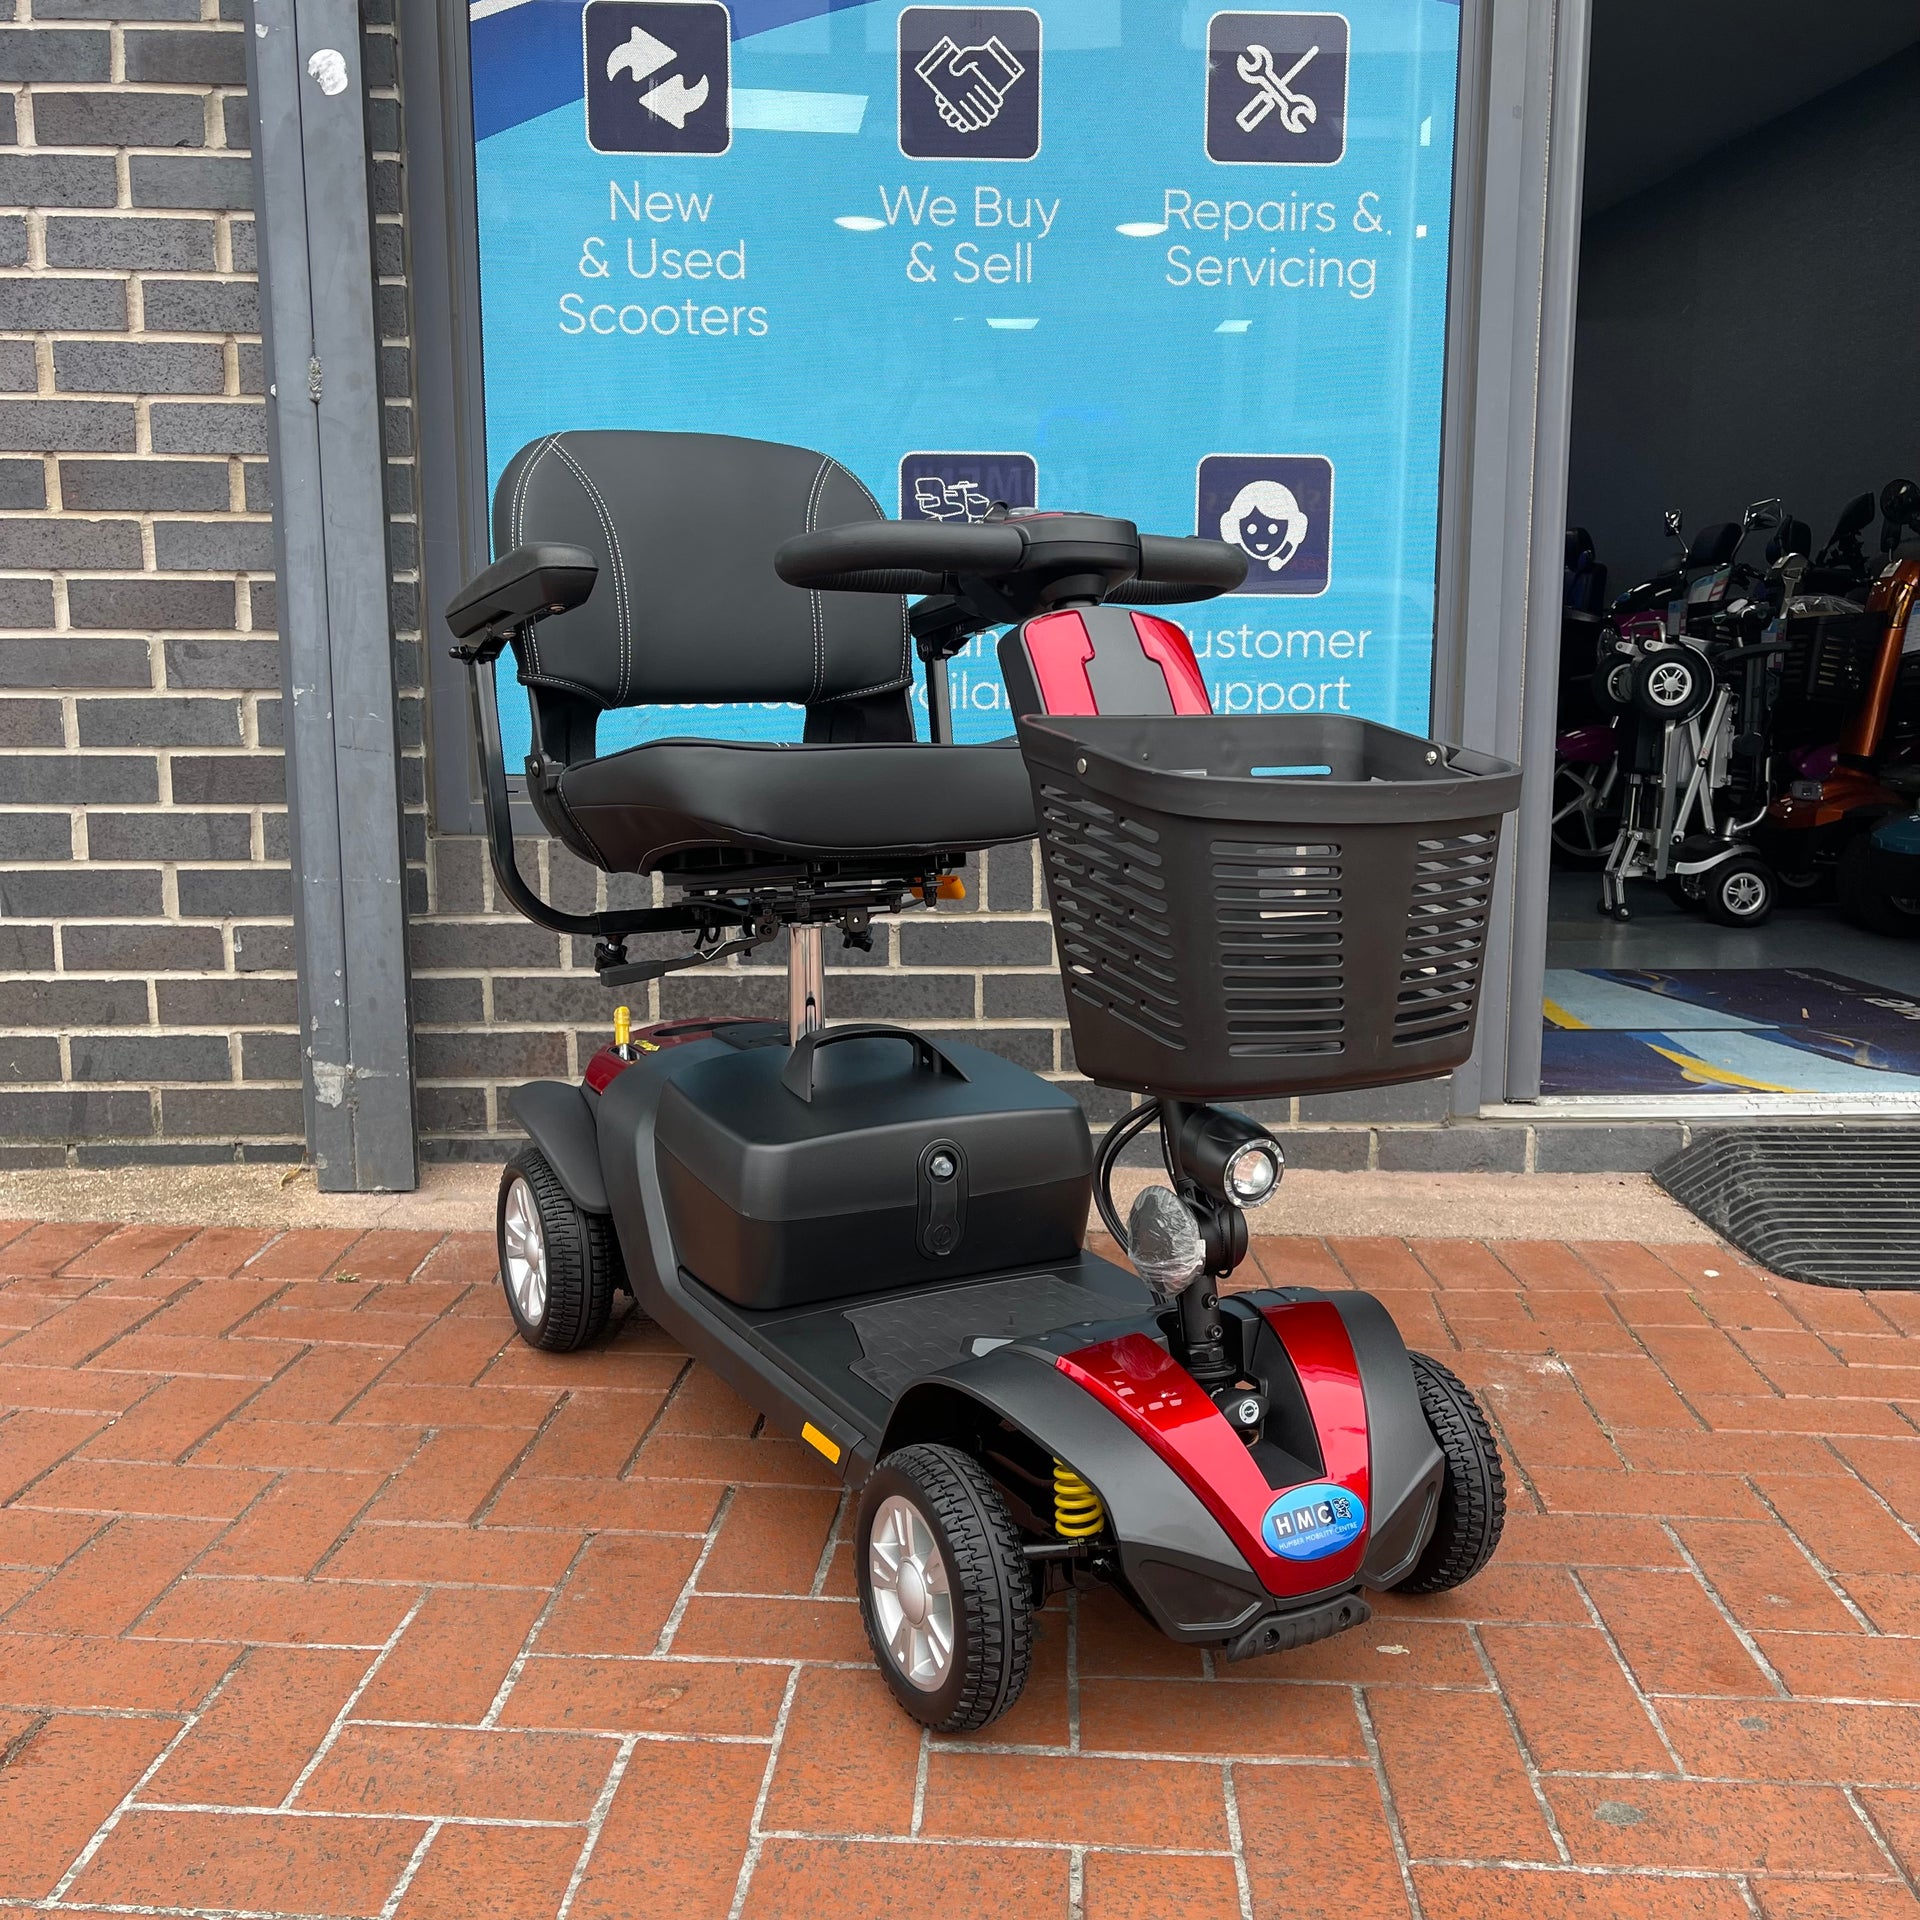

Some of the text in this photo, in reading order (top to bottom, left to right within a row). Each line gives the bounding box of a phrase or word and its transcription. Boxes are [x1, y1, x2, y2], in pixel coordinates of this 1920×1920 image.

[610, 180, 714, 222] New
[879, 185, 1060, 239] We Buy
[1163, 189, 1384, 241] Repairs &
[578, 236, 745, 280] & Used
[906, 241, 1032, 283] & Sell
[1165, 245, 1377, 299] Servicing
[559, 293, 770, 336] Scooters
[1168, 620, 1372, 659] ustomer
[1212, 676, 1351, 714] upport
[1278, 1521, 1358, 1550] HUMBER MOBILITY CENTRE
